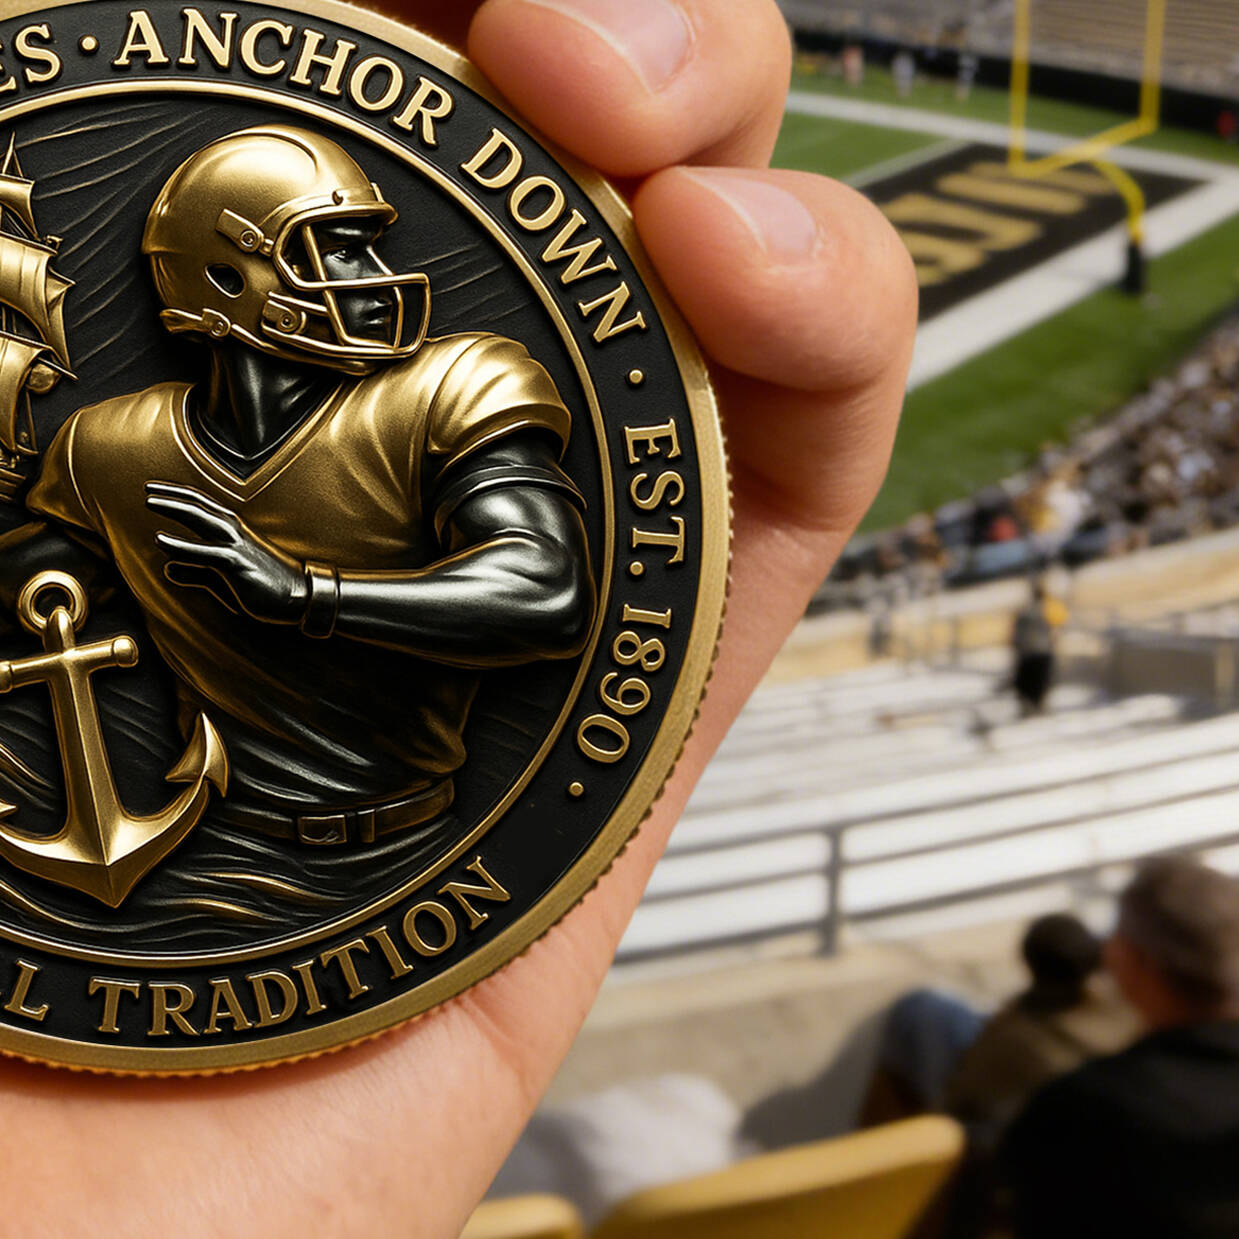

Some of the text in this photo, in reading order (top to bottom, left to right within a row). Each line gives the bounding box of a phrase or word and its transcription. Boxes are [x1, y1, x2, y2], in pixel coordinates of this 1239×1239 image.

[114, 7, 455, 146] ANCHOR
[461, 128, 649, 344] DOWN
[624, 418, 686, 576] EST.
[577, 603, 672, 764] 1890
[88, 855, 511, 1037] TRADITION
